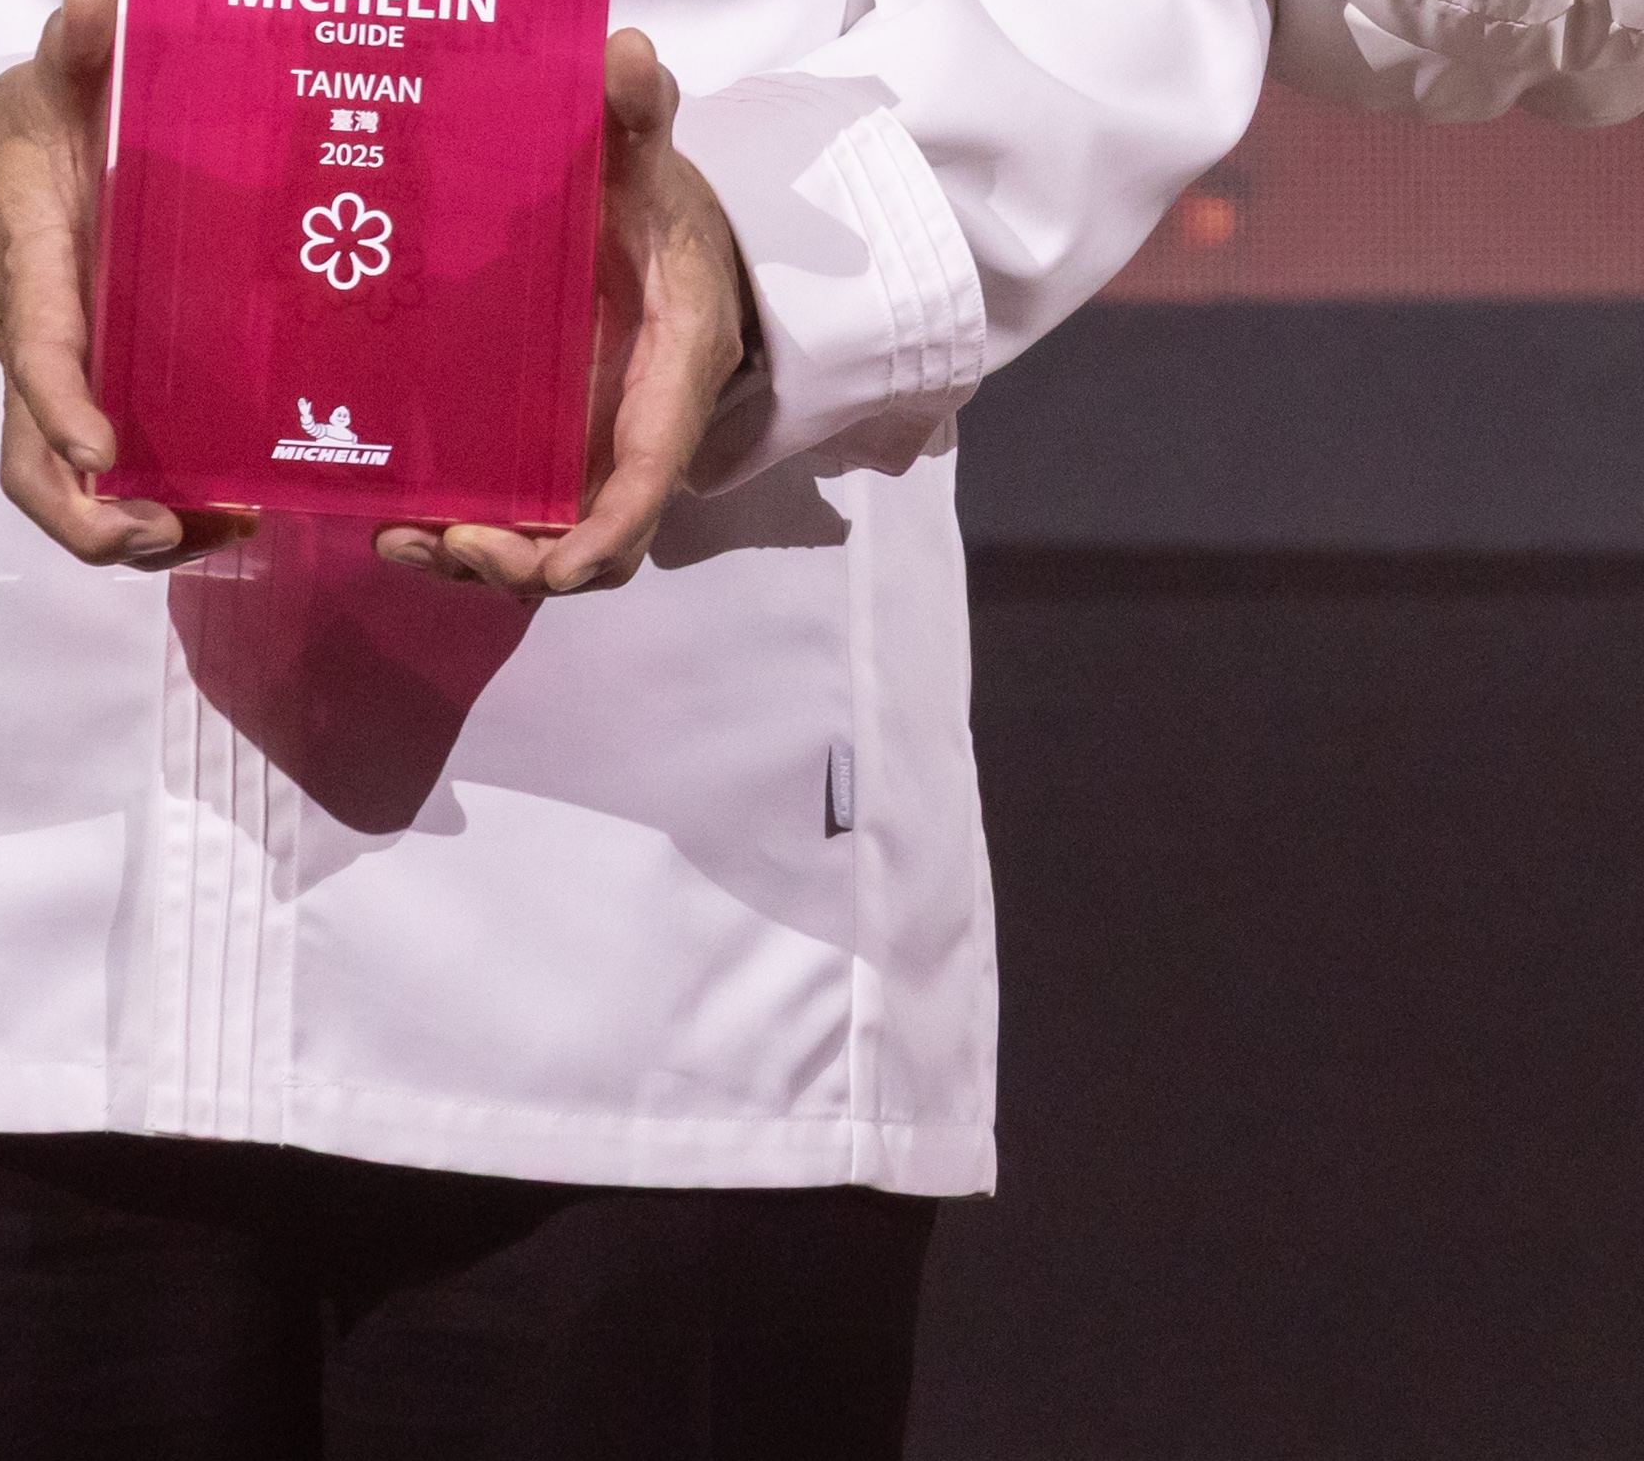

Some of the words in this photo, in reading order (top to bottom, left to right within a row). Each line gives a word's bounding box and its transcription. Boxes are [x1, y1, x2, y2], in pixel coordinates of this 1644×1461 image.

[314, 21, 405, 48] GUIDE
[290, 68, 423, 104] TAIWAN
[329, 108, 379, 134] 臺灣
[319, 142, 384, 168] 2025
[270, 445, 391, 466] MICHELIN
